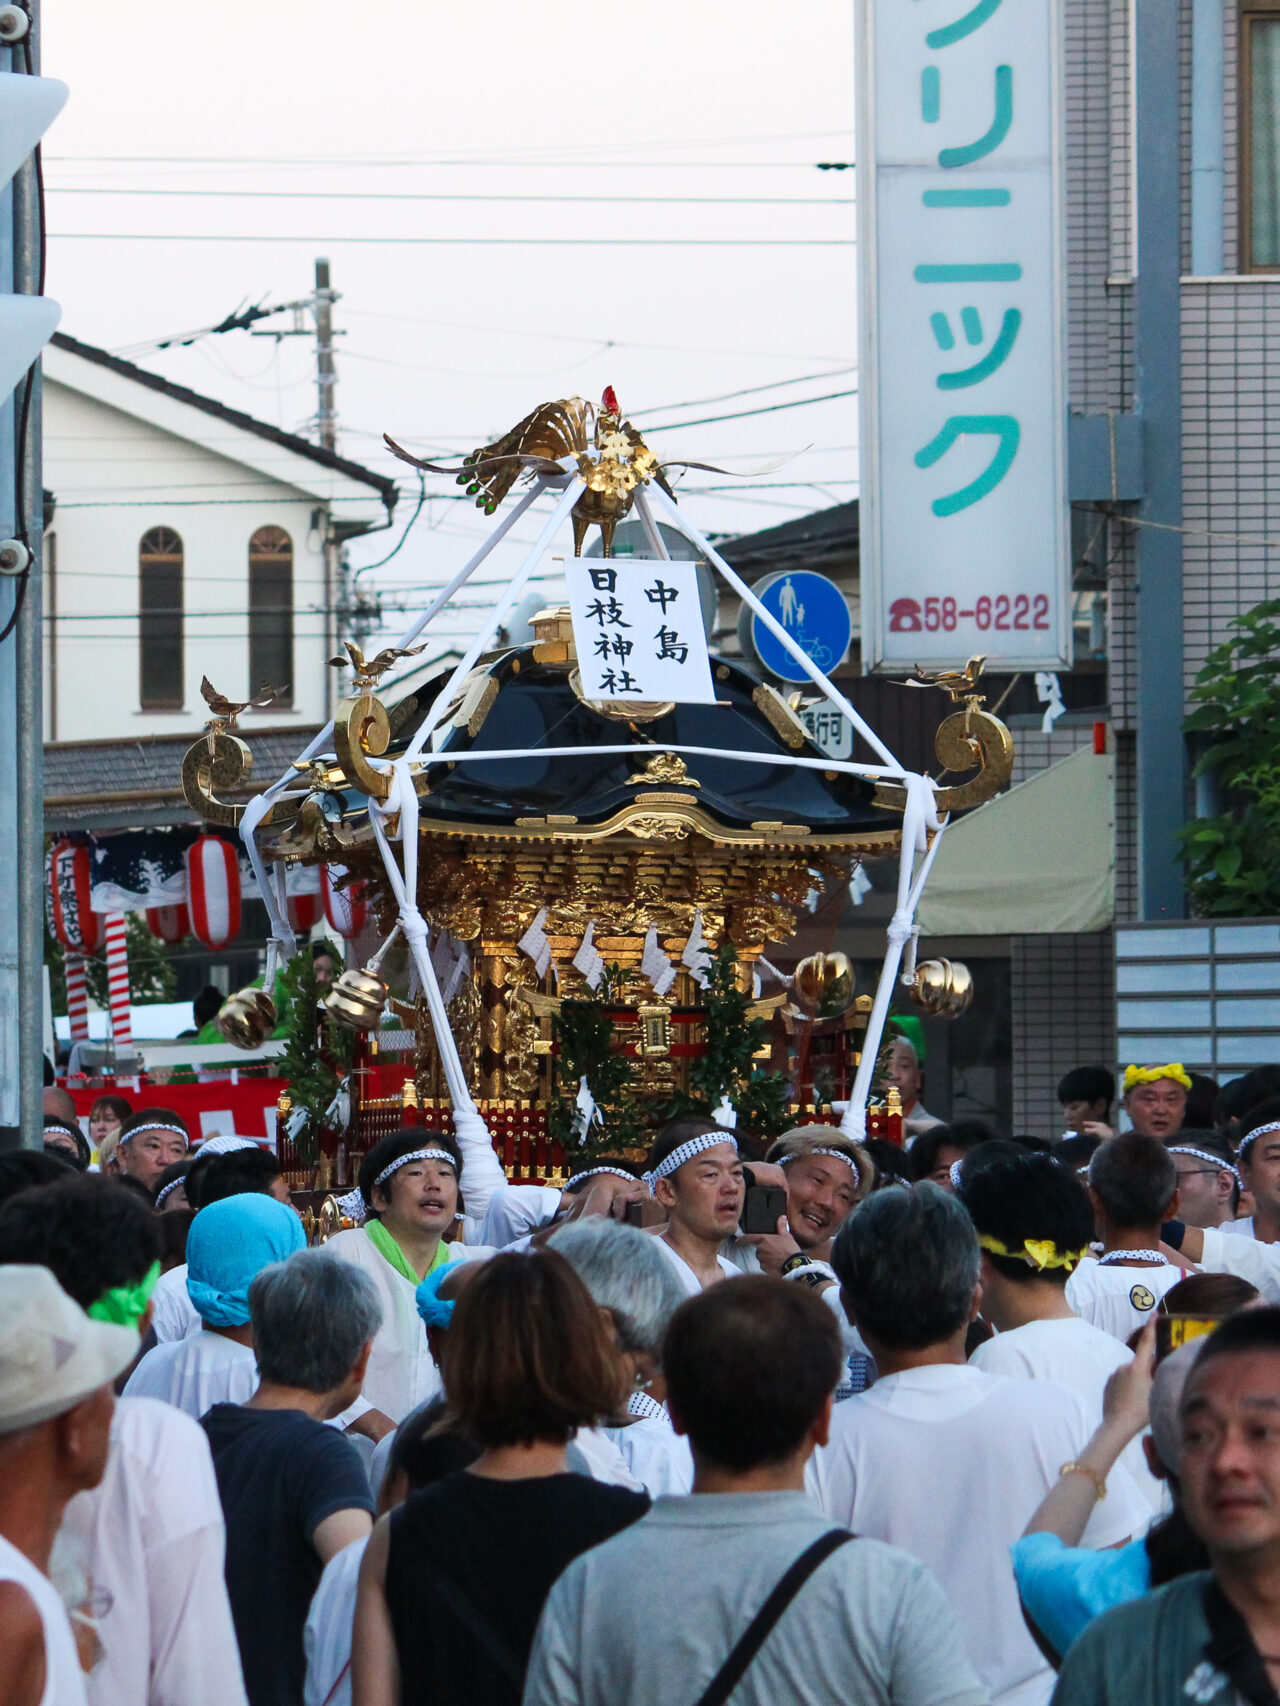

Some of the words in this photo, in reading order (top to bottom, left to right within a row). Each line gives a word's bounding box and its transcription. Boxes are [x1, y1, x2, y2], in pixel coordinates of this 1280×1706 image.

[584, 568, 643, 695] 日枝神社
[643, 579, 689, 664] 中島
